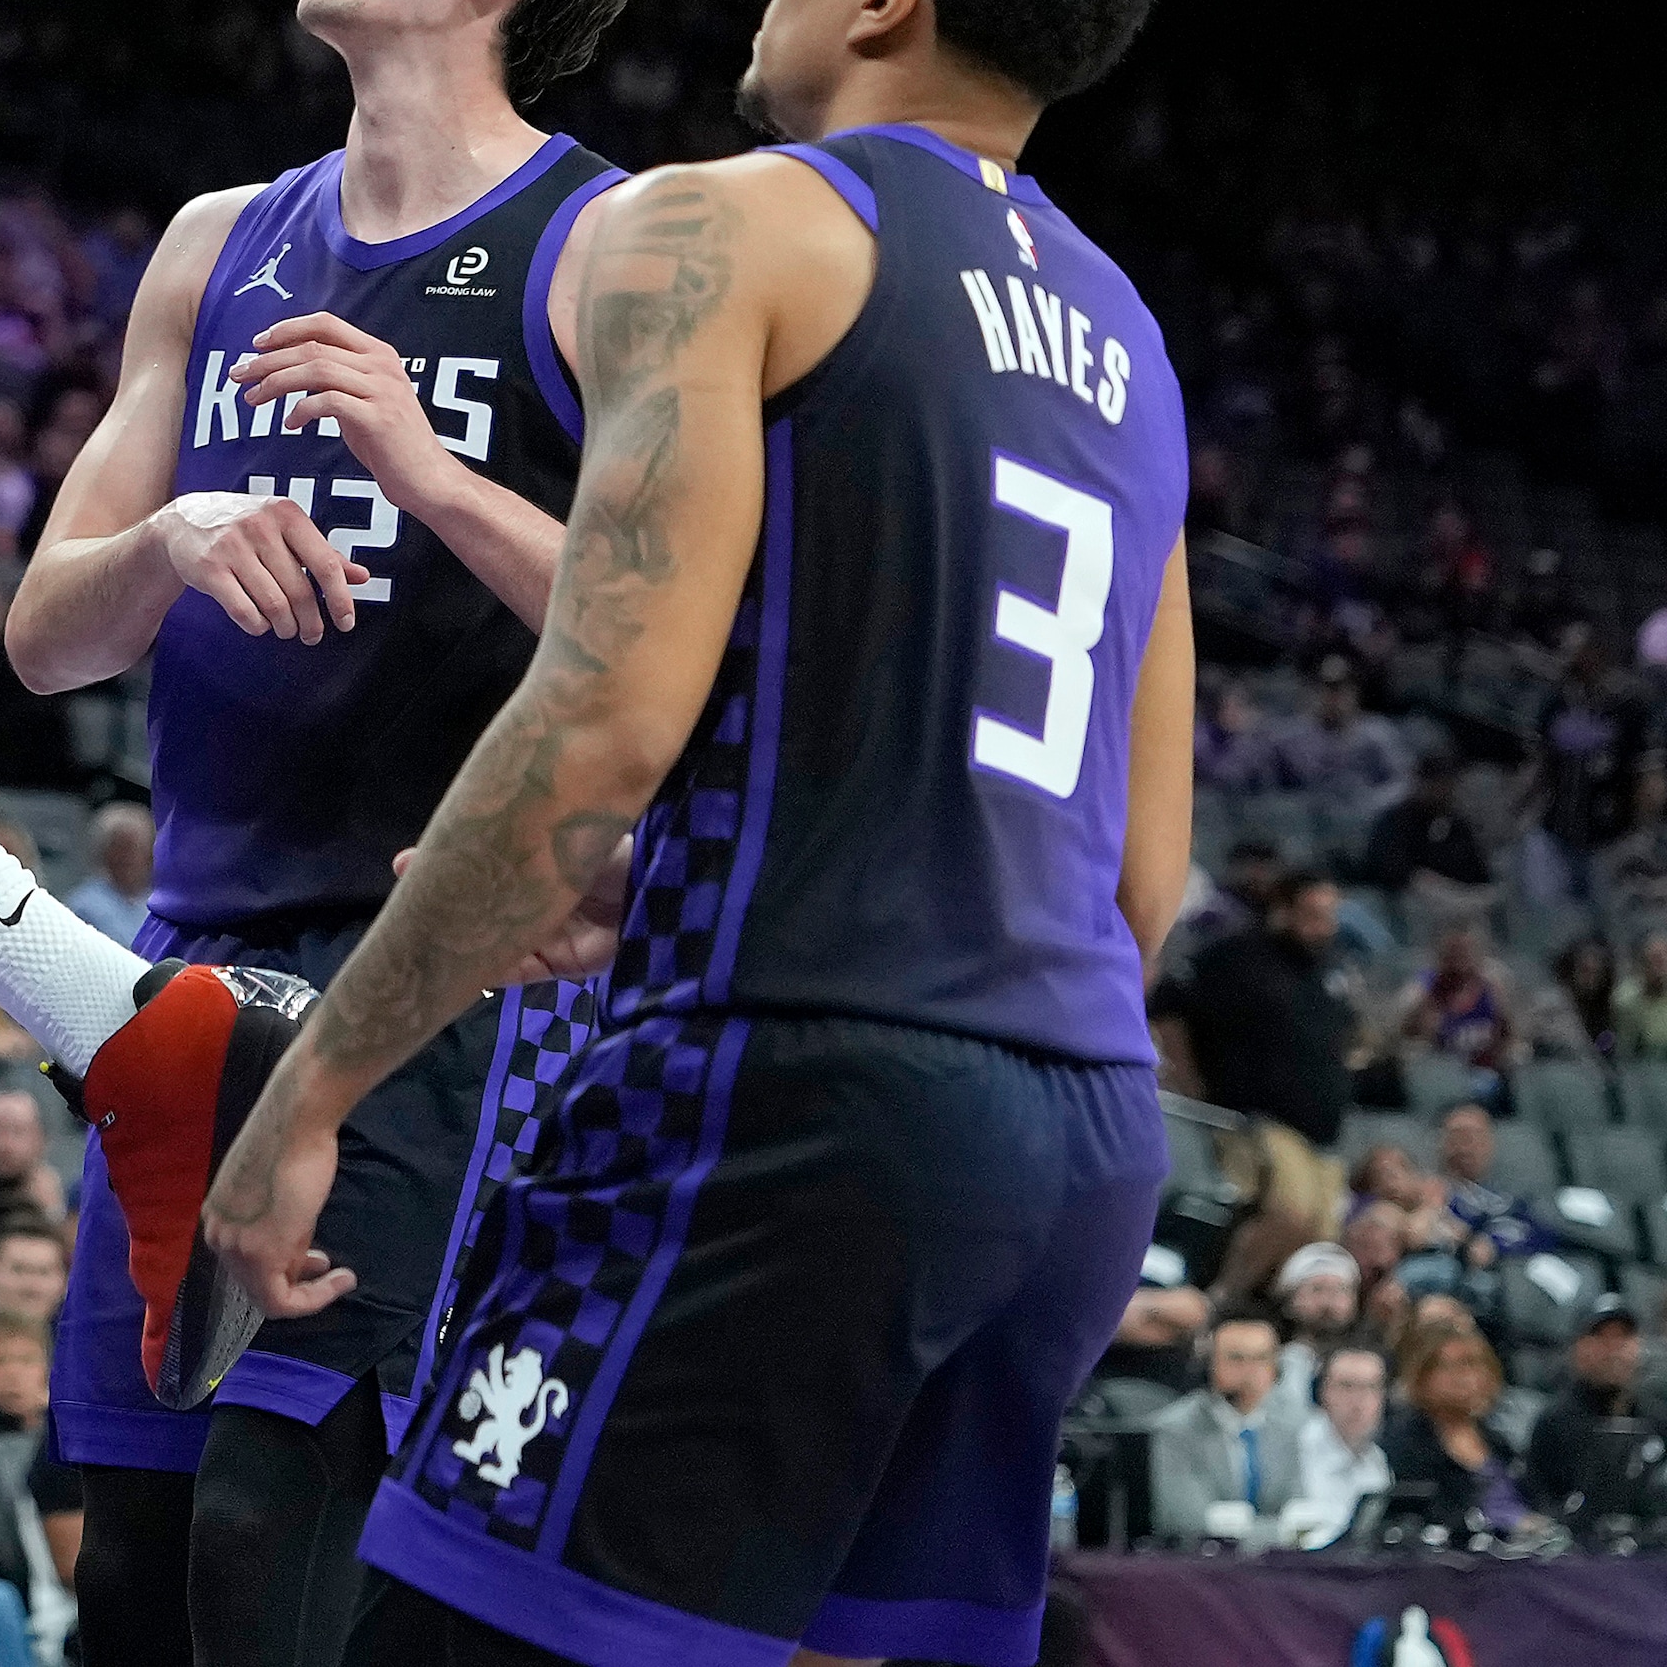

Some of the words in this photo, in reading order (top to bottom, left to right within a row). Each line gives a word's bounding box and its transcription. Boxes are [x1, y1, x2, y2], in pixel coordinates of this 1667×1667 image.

[424, 285, 470, 296] PHOONG
[470, 287, 497, 297] LAW
[959, 267, 1132, 426] HAYES
[974, 455, 1115, 800] 3
